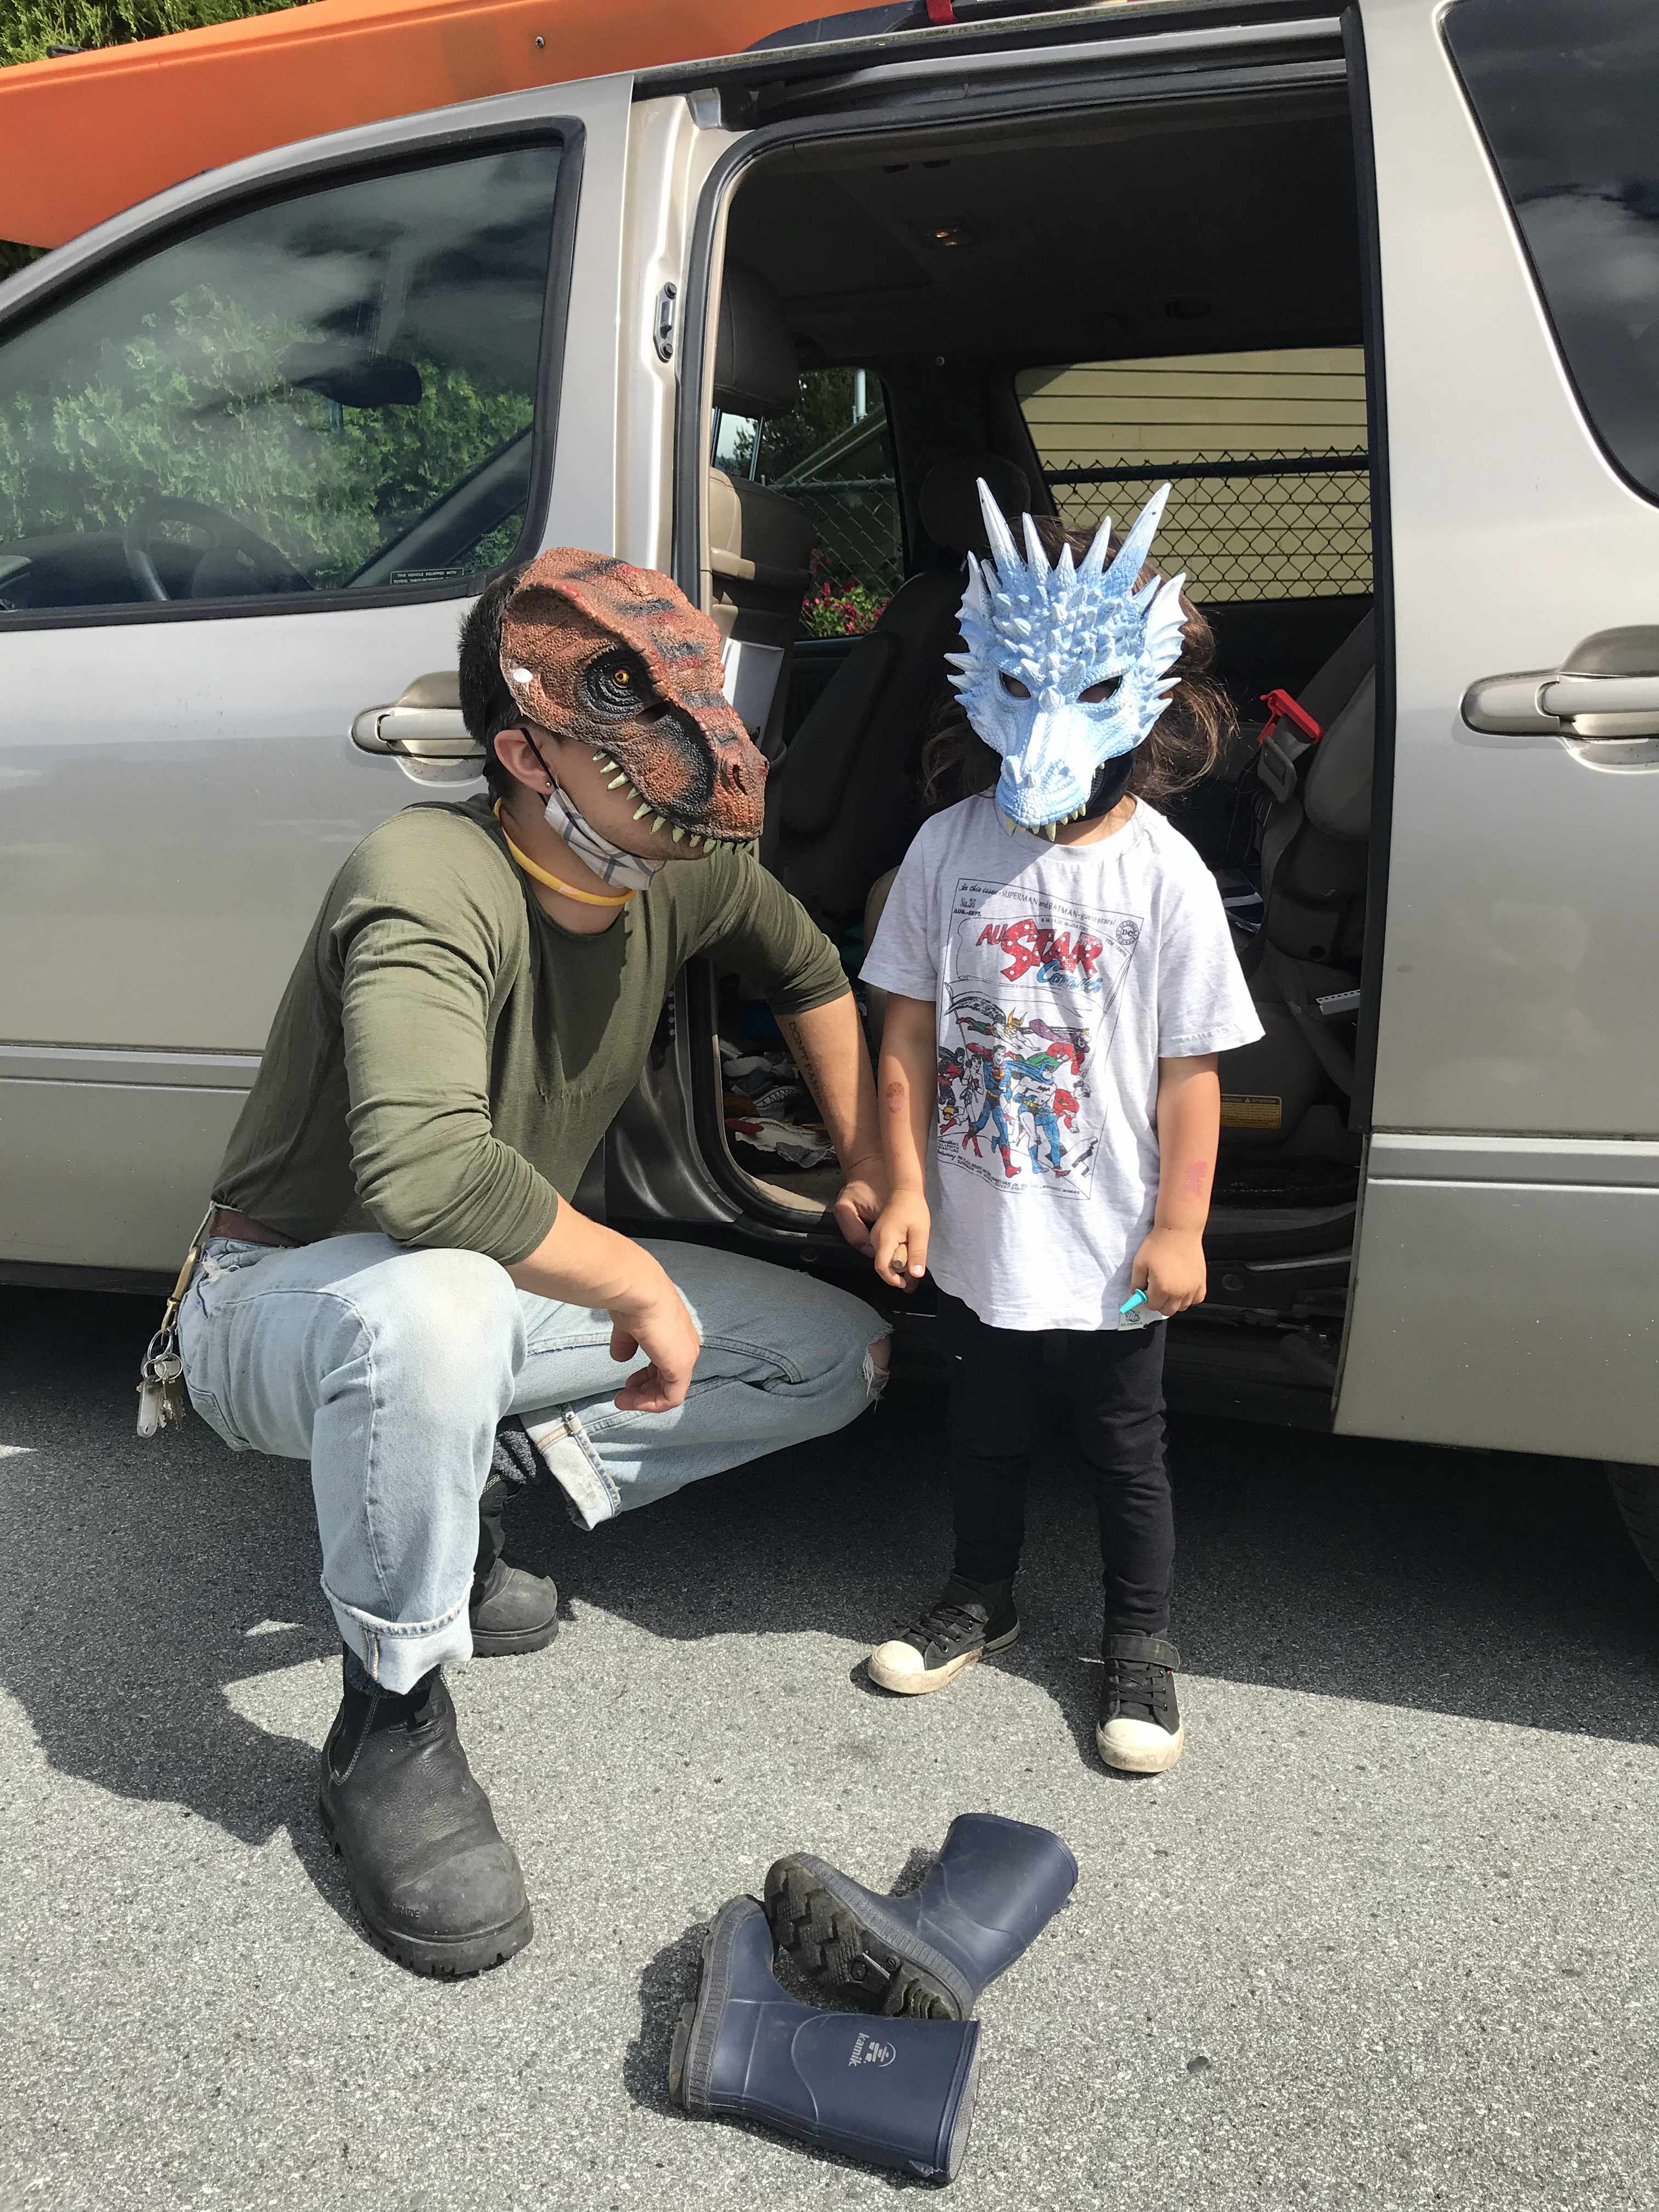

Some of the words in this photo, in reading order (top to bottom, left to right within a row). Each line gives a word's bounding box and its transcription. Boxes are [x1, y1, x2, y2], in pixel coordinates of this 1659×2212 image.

[969, 884, 981, 893] this
[975, 924, 1008, 946] ALL
[1000, 918, 1103, 982] STAR
[848, 2032, 870, 2067] kamik
